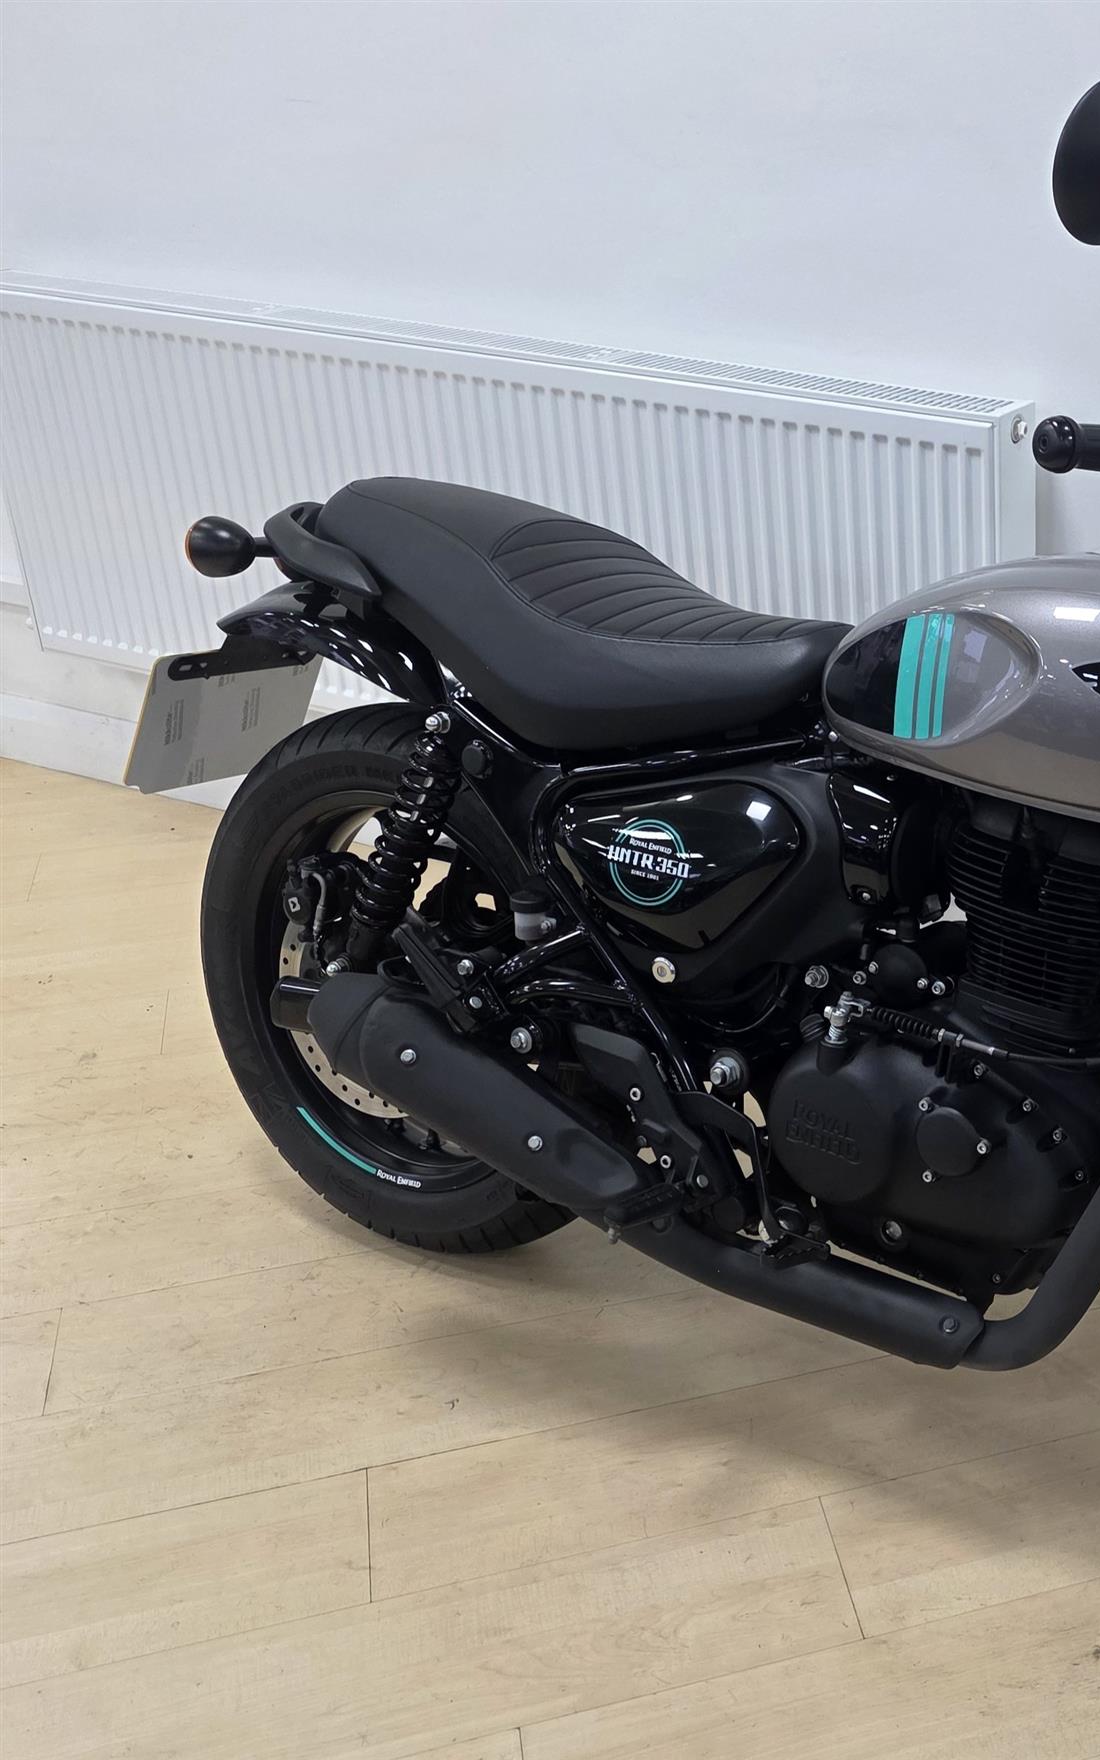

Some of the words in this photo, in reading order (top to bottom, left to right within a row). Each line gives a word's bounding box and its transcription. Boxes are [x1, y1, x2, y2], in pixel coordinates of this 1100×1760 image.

[629, 837, 648, 849] ROYAL
[648, 842, 672, 855] ENFIELD
[655, 856, 690, 879] 350
[376, 1169, 397, 1183] ROYAL
[396, 1176, 422, 1189] ENFIELD
